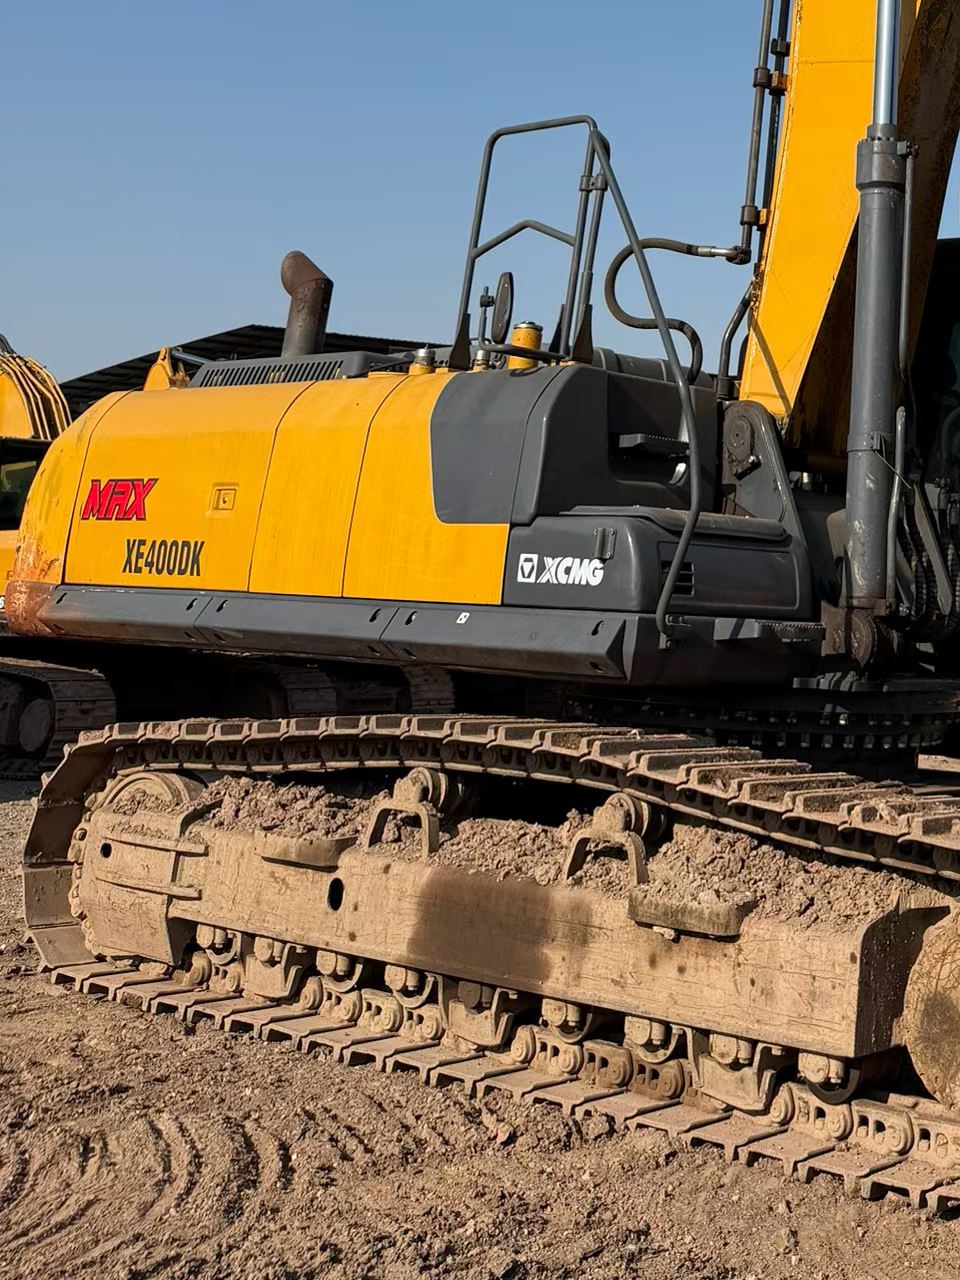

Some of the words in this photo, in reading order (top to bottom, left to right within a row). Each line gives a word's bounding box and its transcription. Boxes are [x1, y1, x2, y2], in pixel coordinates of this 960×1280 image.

[81, 478, 159, 520] MAX
[122, 539, 205, 576] XE400DK
[536, 556, 604, 586] XCMG
